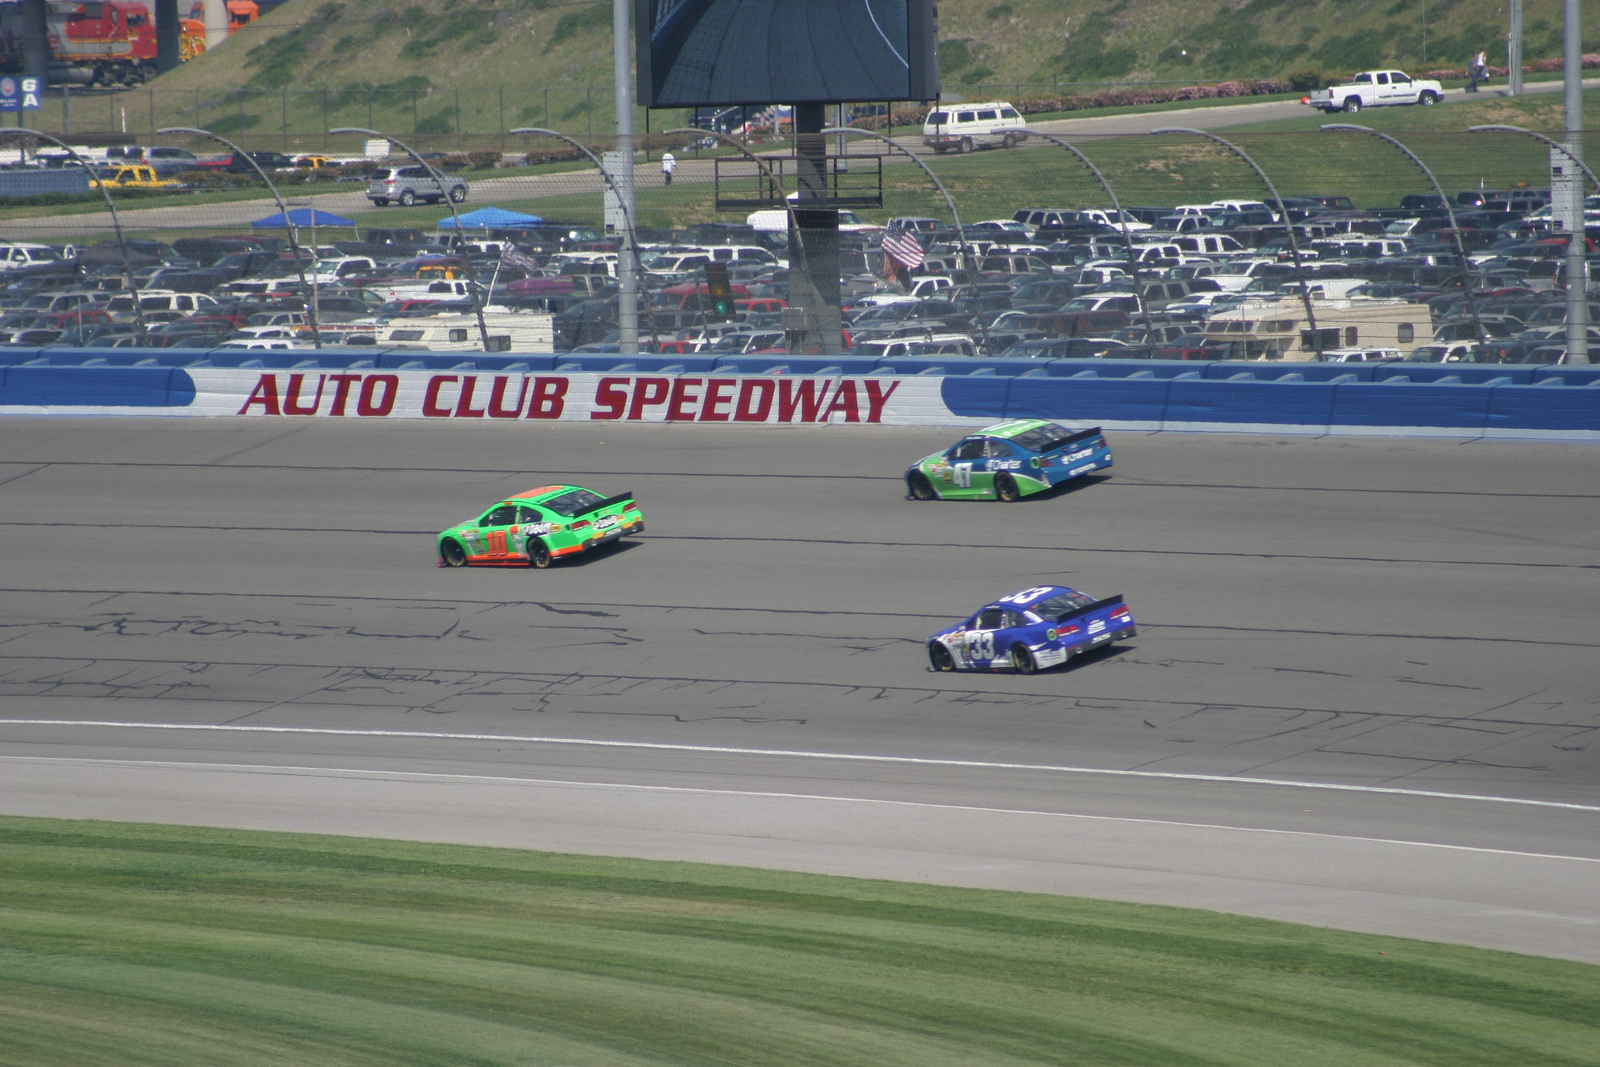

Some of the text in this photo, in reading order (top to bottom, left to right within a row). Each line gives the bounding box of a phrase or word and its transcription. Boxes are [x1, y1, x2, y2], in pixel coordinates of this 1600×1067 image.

[22, 93, 38, 107] A
[238, 374, 900, 423] AUTO CLUB SPEEDWAY
[953, 462, 973, 488] 47
[992, 459, 1022, 471] Charter
[485, 530, 508, 556] 10
[971, 632, 995, 660] 33
